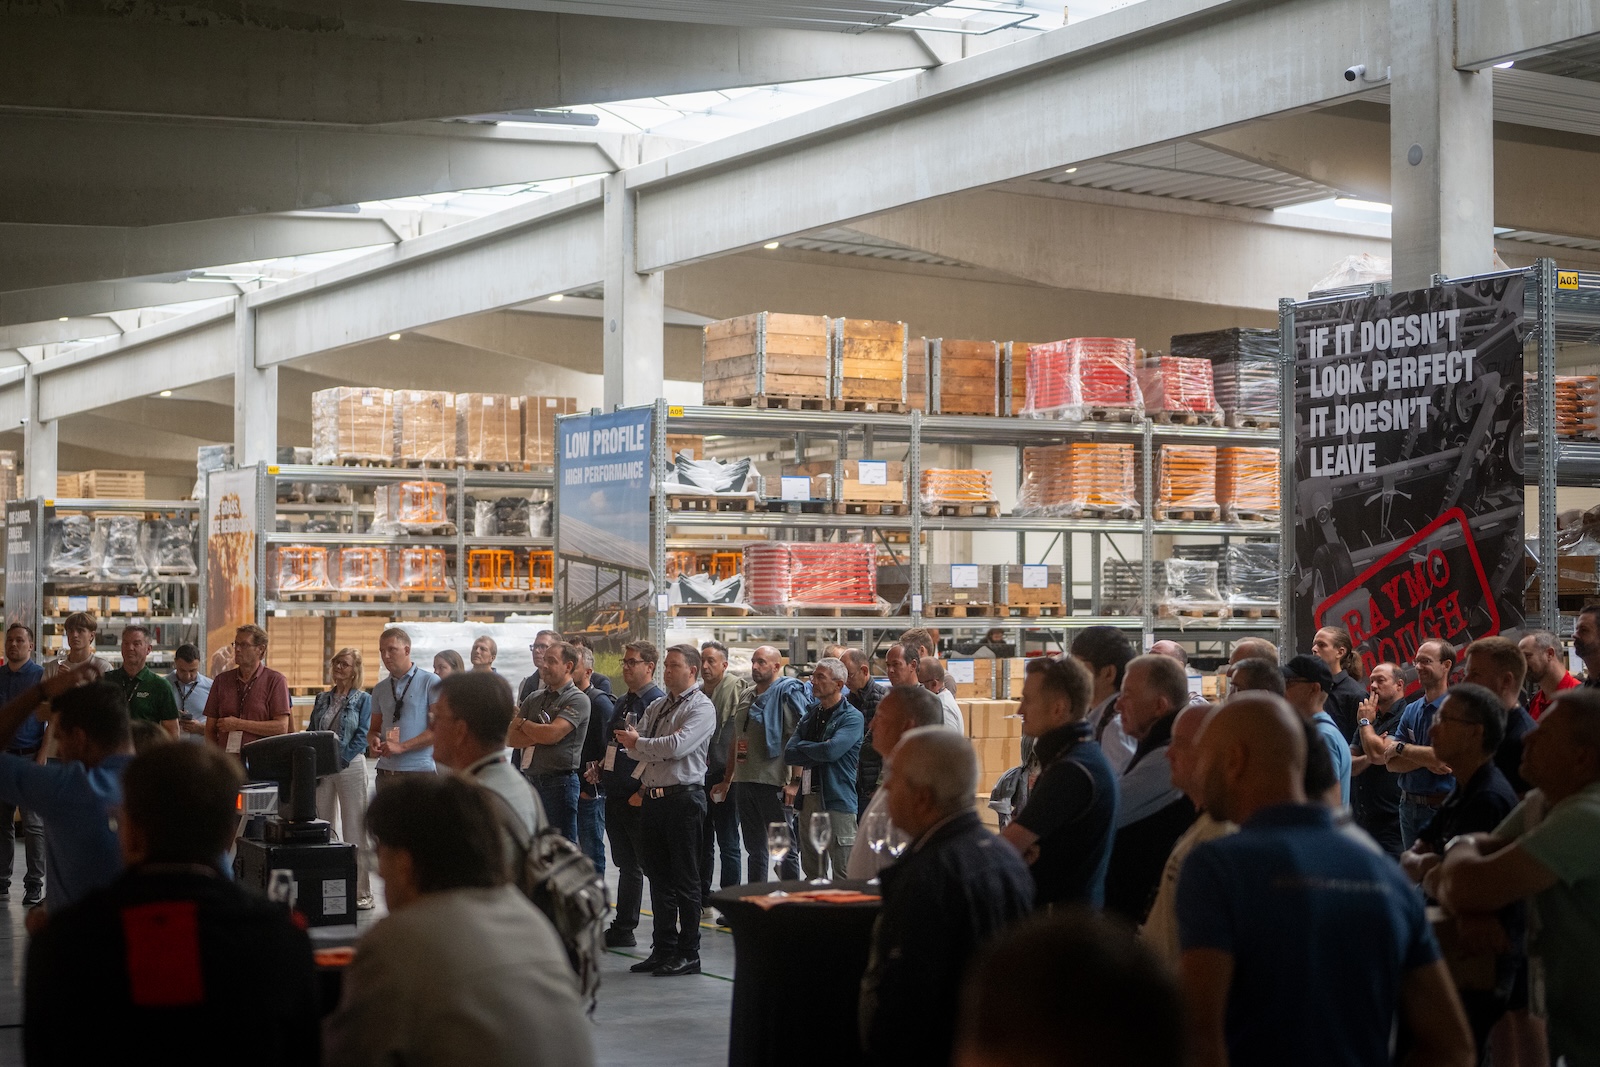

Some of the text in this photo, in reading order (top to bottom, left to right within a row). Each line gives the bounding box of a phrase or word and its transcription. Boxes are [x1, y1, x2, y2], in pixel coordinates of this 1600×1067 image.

[1559, 276, 1578, 286] A03
[1309, 309, 1461, 359] IF IT DOESN'T
[1309, 349, 1477, 398] LOOK PERFECT
[1309, 396, 1431, 438] IT DOESN'T
[565, 424, 645, 459] LOW PROFILE
[1309, 442, 1377, 478] LEAVE
[565, 461, 644, 485] HIGH PERFORMANCE
[1341, 548, 1450, 649] RAYMO
